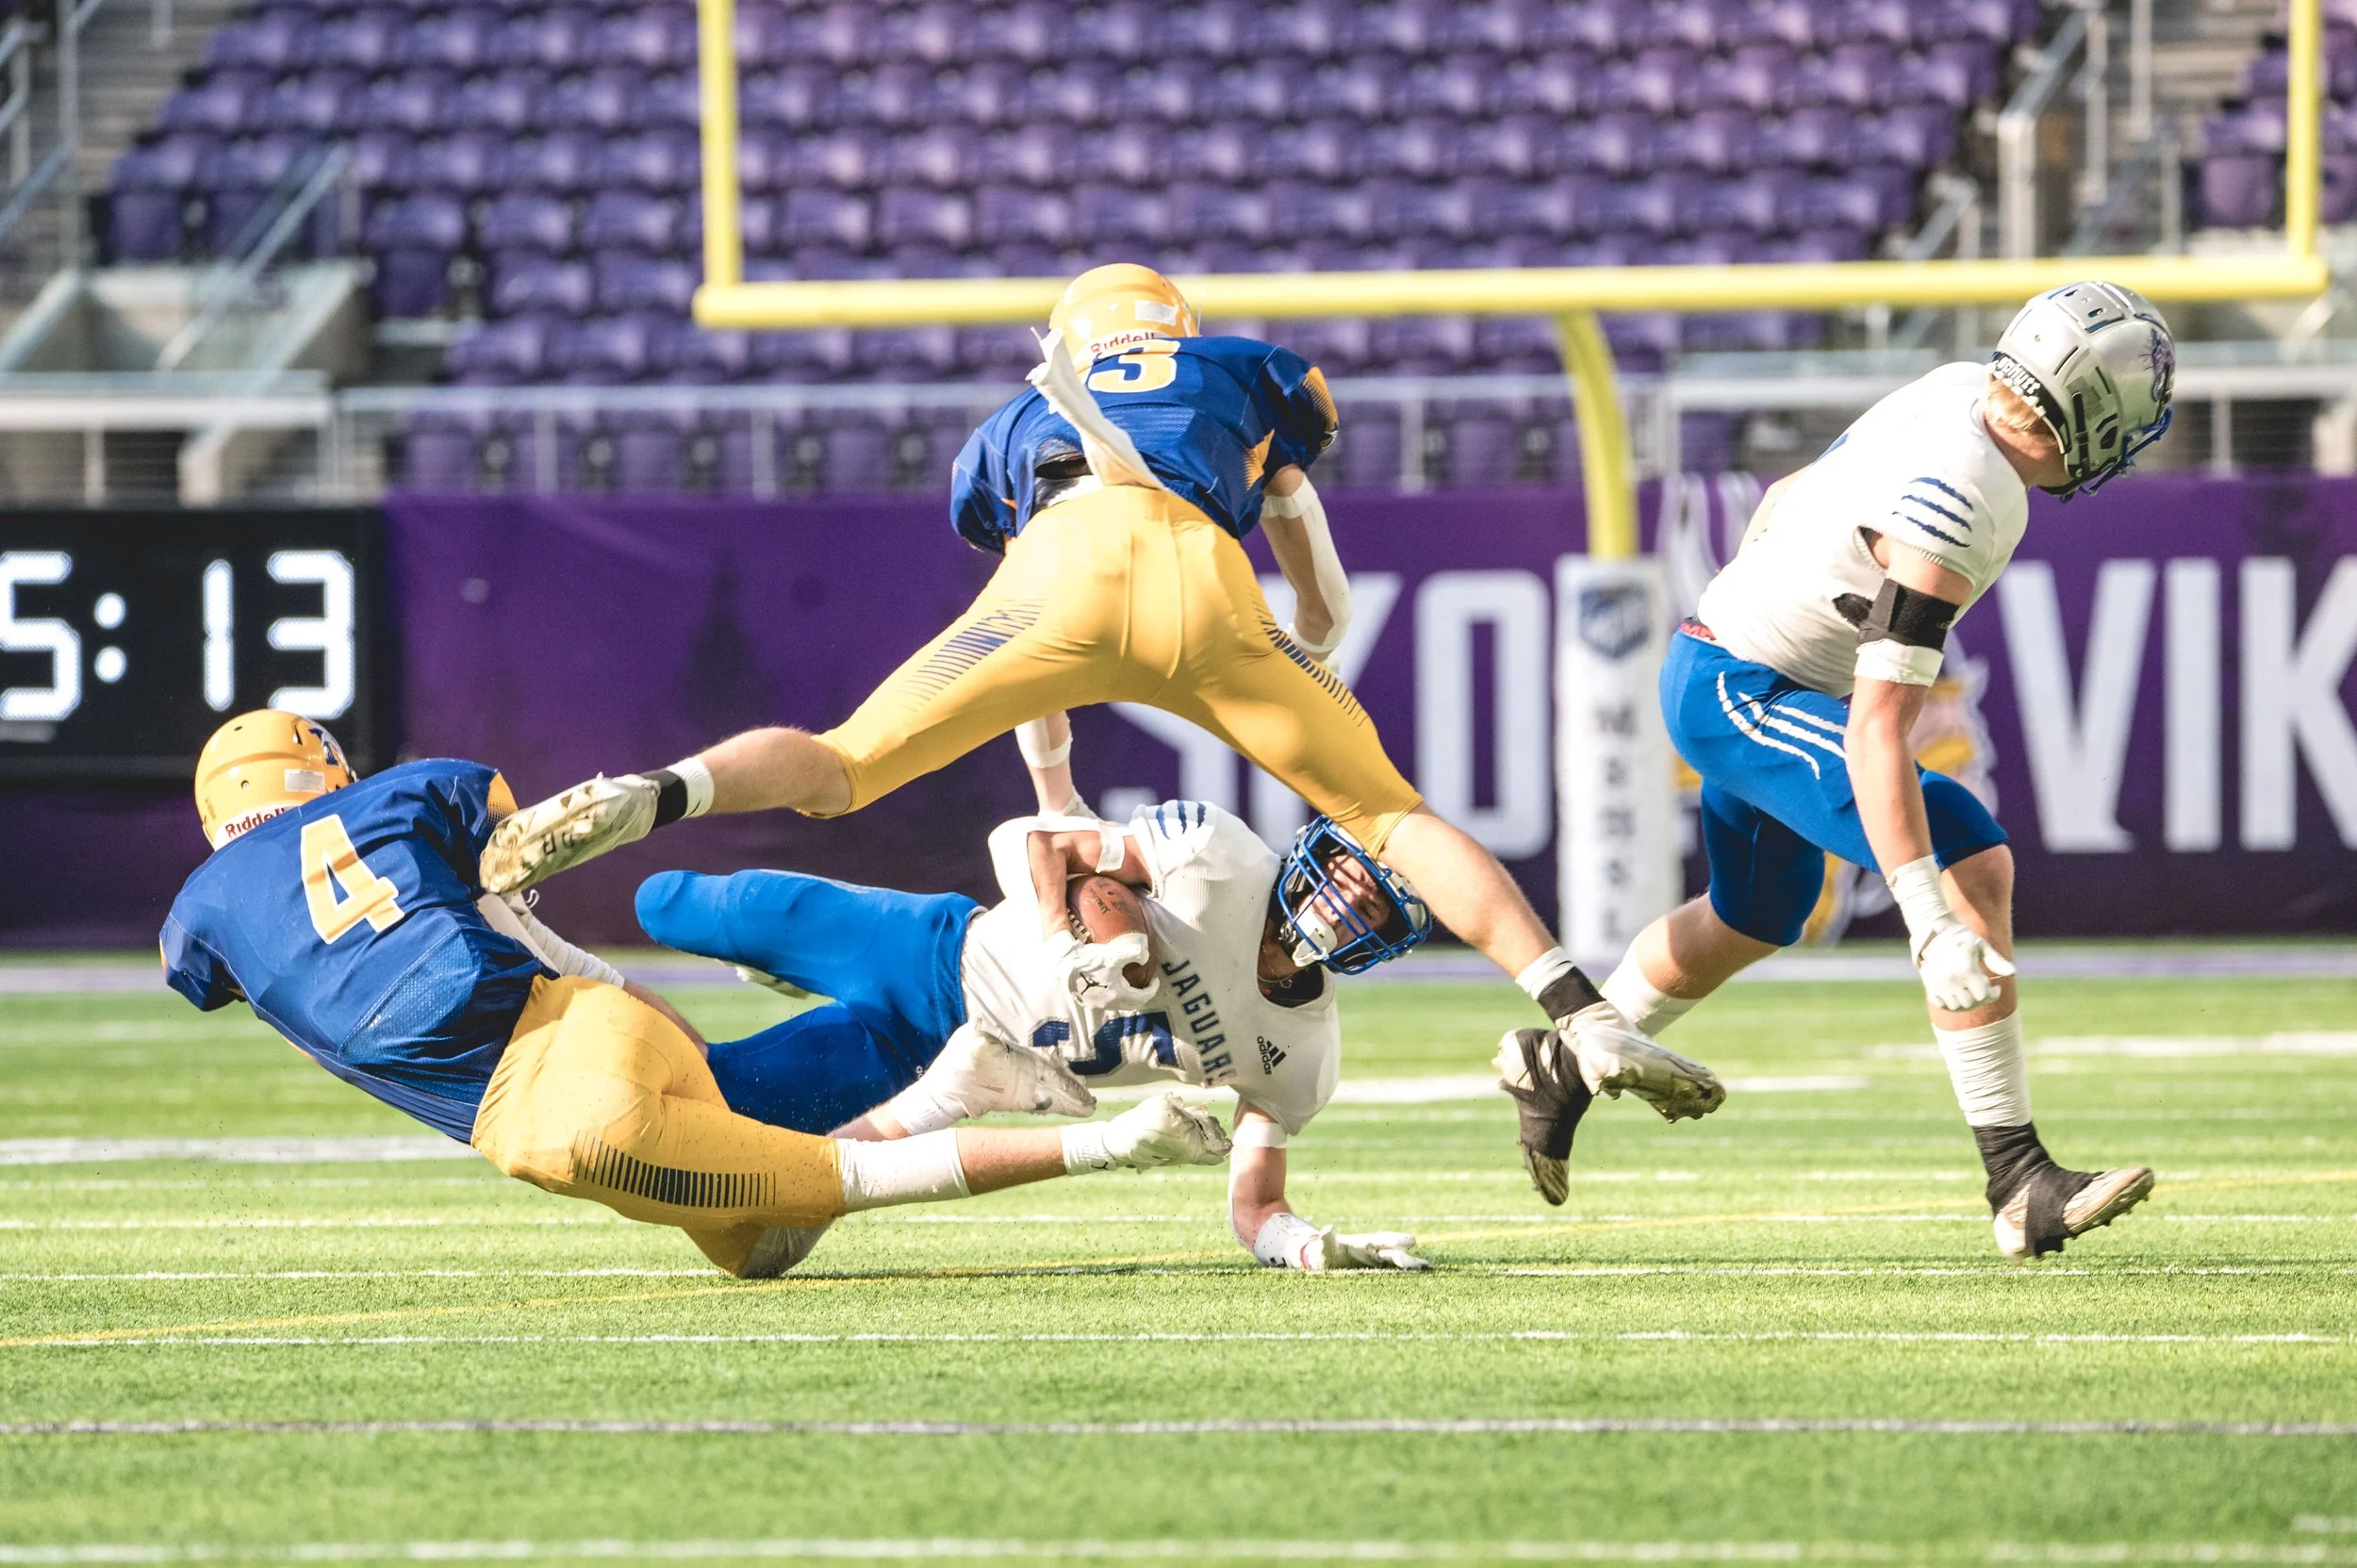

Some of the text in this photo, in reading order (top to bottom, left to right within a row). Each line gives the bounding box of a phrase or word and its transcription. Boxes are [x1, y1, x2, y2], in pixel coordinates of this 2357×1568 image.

[0, 551, 354, 720] 5:13
[1993, 554, 2357, 853] VIK
[301, 814, 405, 944] 4
[1257, 1035, 1273, 1076] adidas
